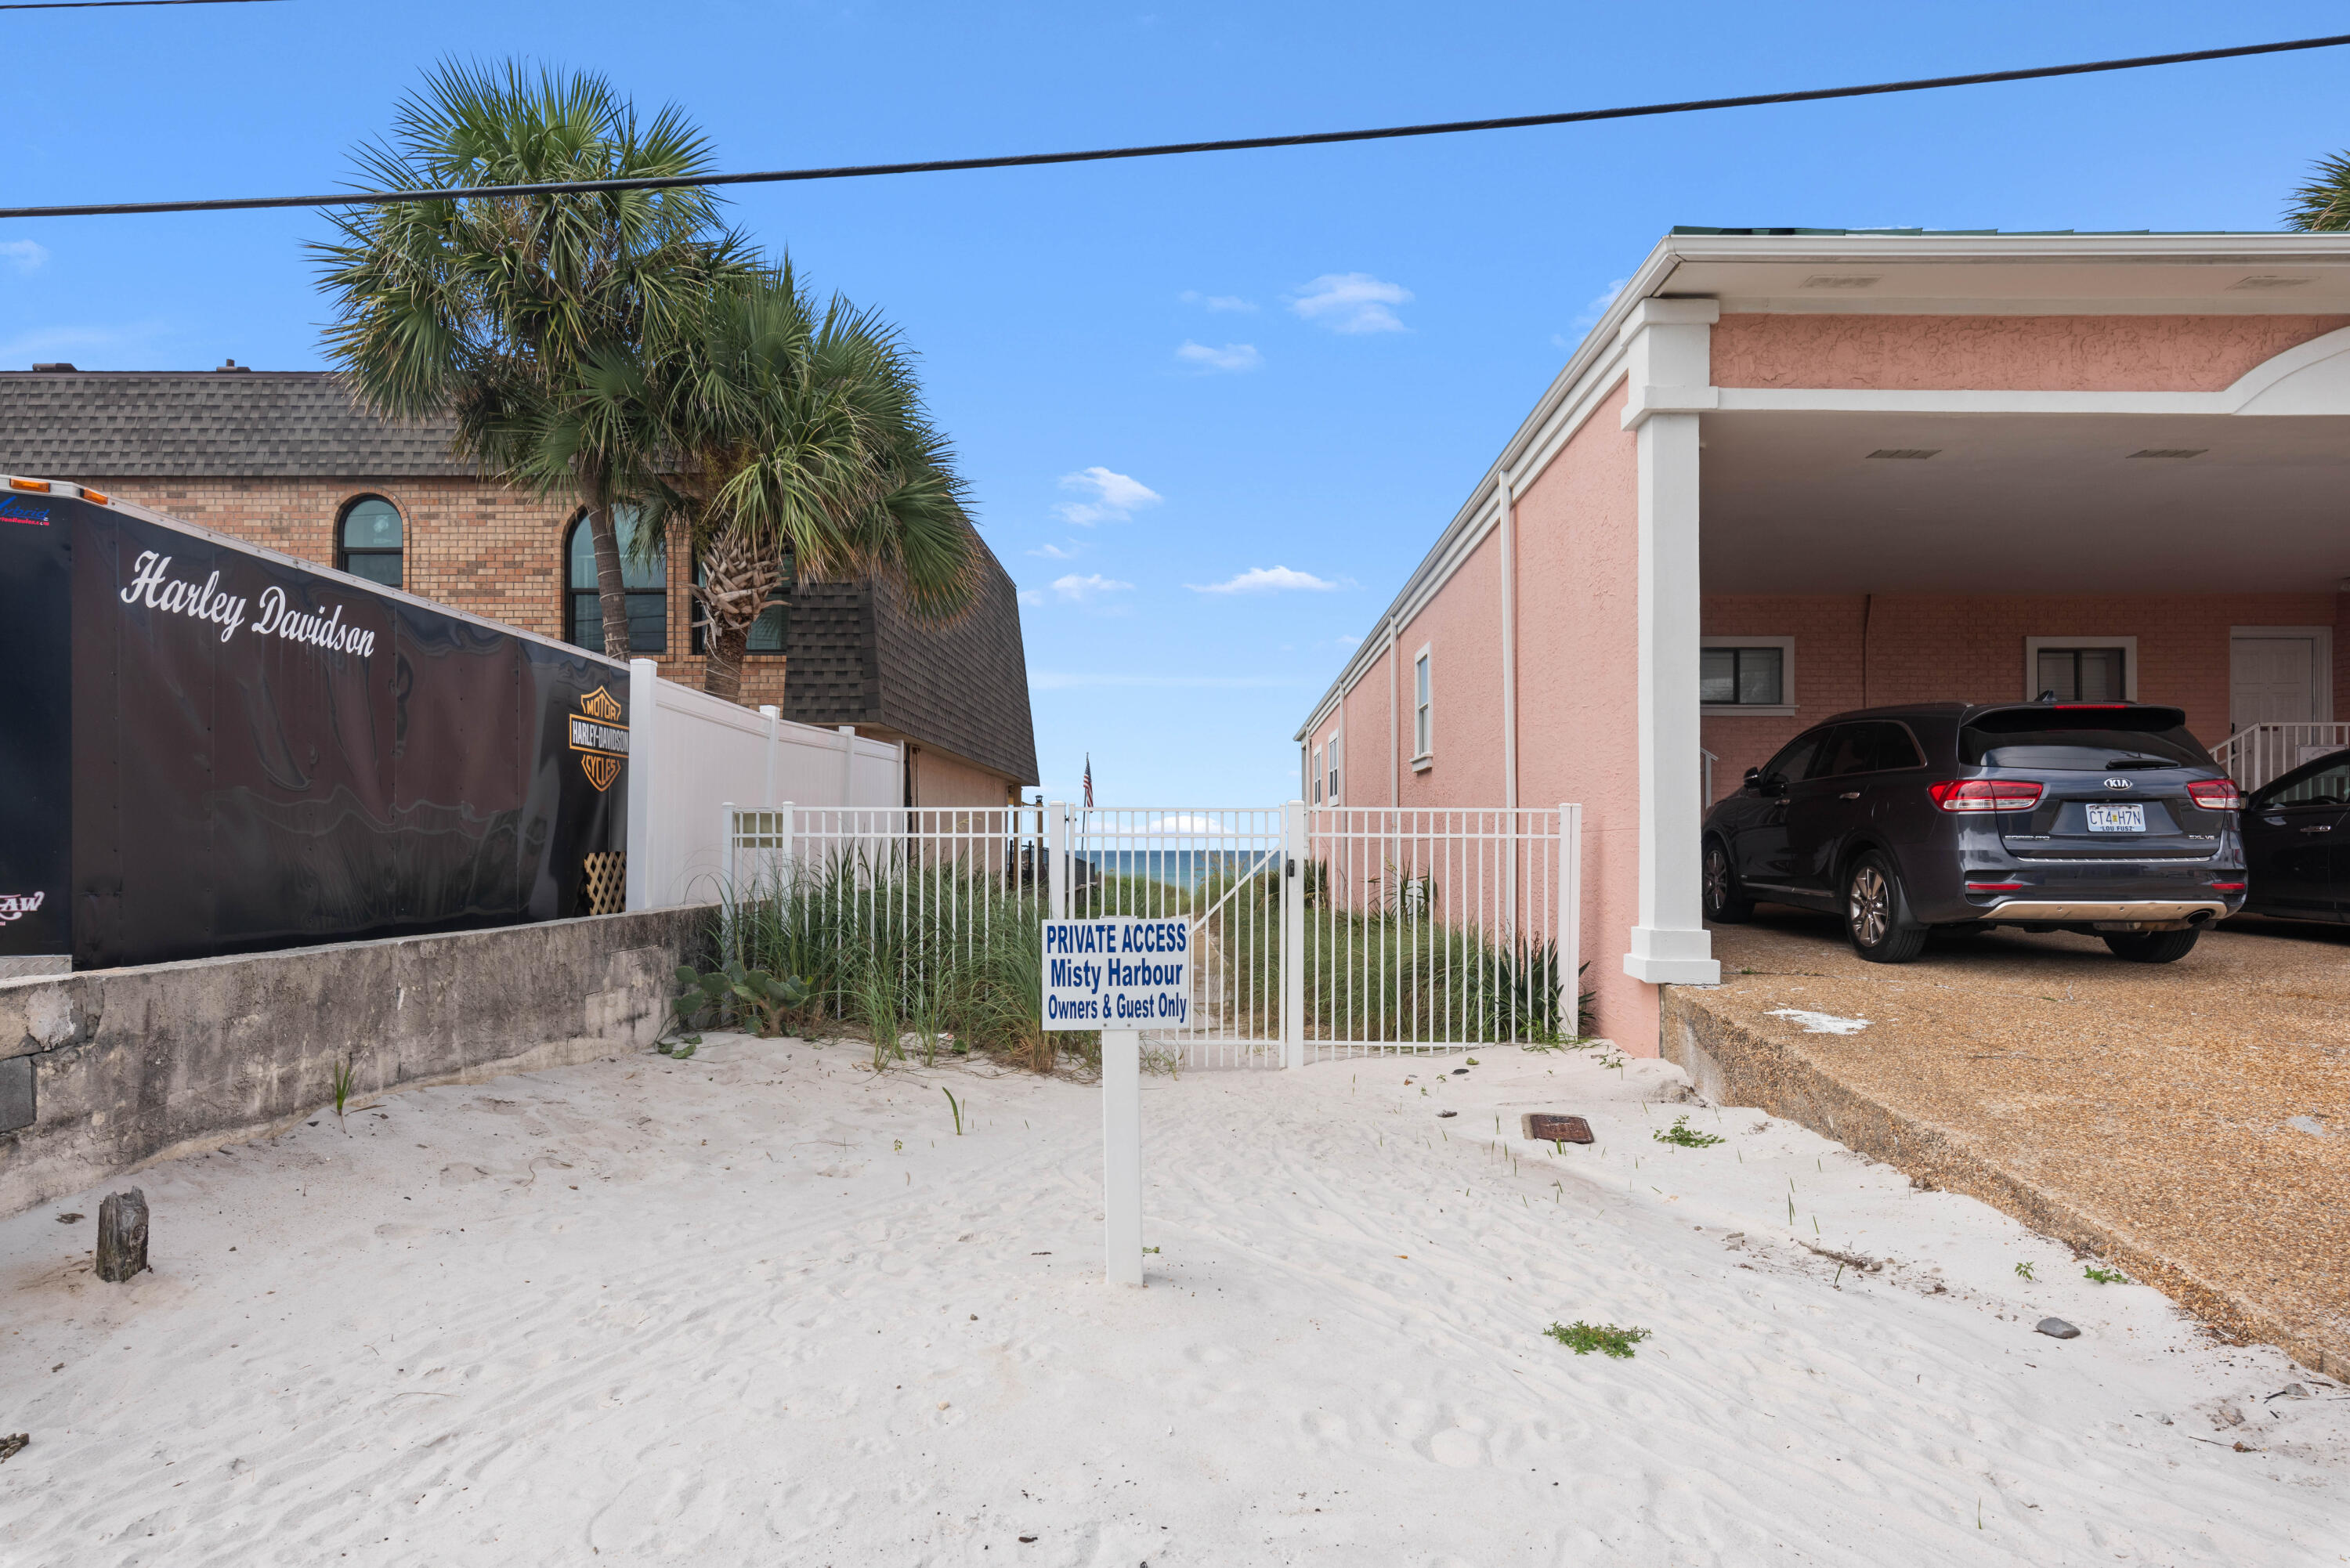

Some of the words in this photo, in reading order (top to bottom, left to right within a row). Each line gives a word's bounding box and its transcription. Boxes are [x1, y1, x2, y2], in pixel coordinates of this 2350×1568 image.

[120, 550, 247, 642] Harley
[251, 586, 374, 657] Davidson
[586, 692, 616, 721] MOTOR
[572, 720, 629, 753] HARLEY-DAVIDSON
[586, 754, 616, 786] CYCLES
[2109, 779, 2129, 788] KIA
[1047, 925, 1116, 953] PRIVATE
[1122, 923, 1187, 952] ACCESS
[1050, 959, 1101, 994] Misty
[1108, 957, 1183, 987] Harbour
[1048, 994, 1097, 1019] Owners
[1103, 993, 1112, 1019] &
[1116, 992, 1155, 1019] Guest
[1159, 992, 1187, 1023] Only
